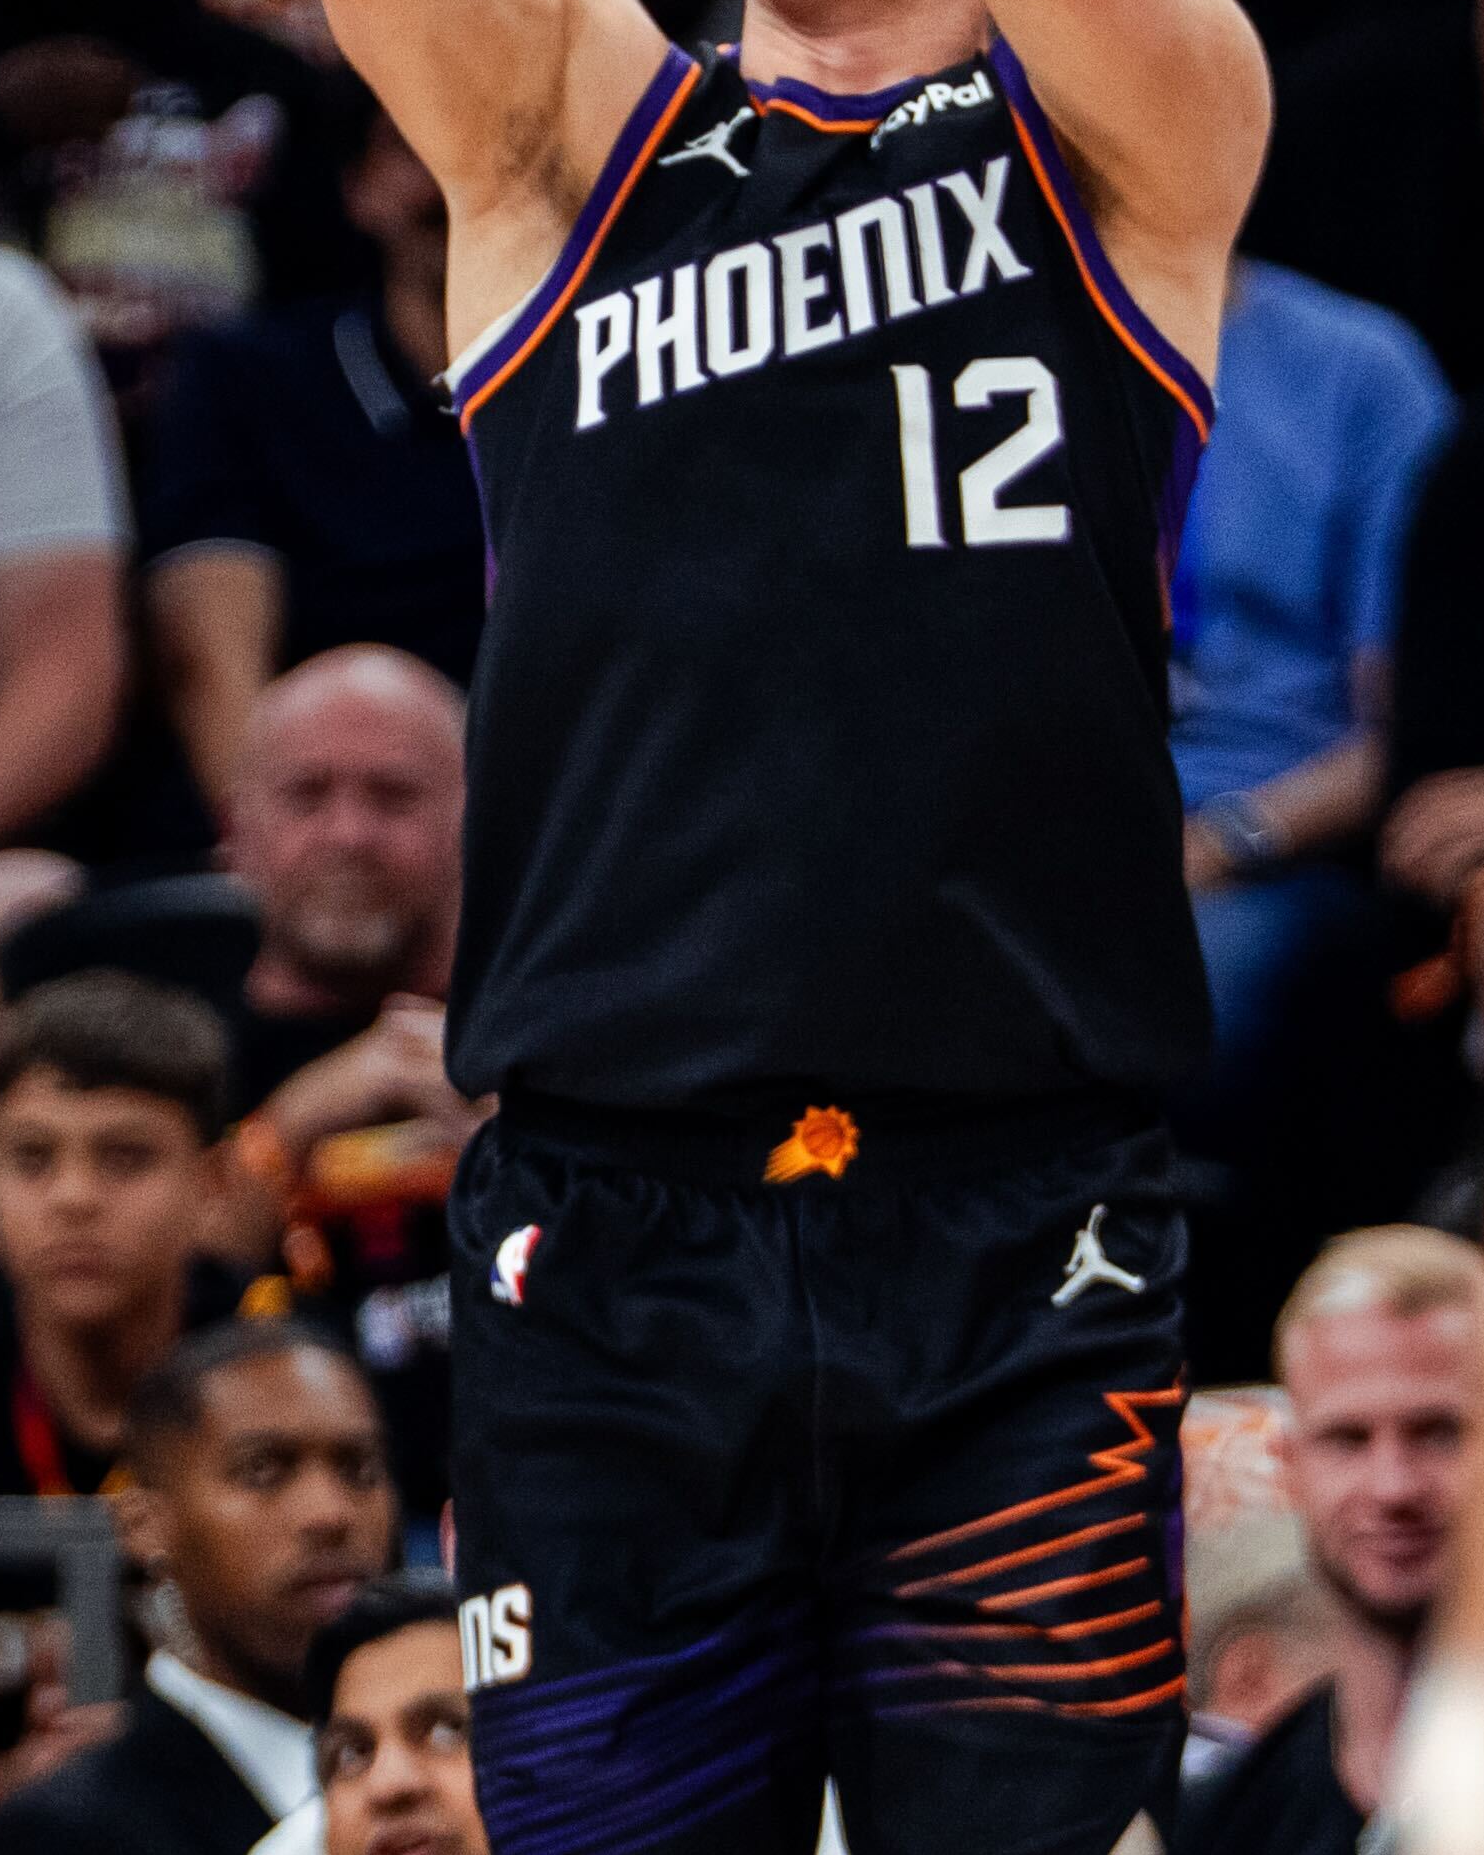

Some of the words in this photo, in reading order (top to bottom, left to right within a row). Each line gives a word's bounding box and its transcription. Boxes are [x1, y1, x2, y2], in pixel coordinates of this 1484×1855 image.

[574, 155, 1034, 434] PHOENIX
[889, 356, 1070, 548] 12
[458, 1581, 534, 1695] NS
